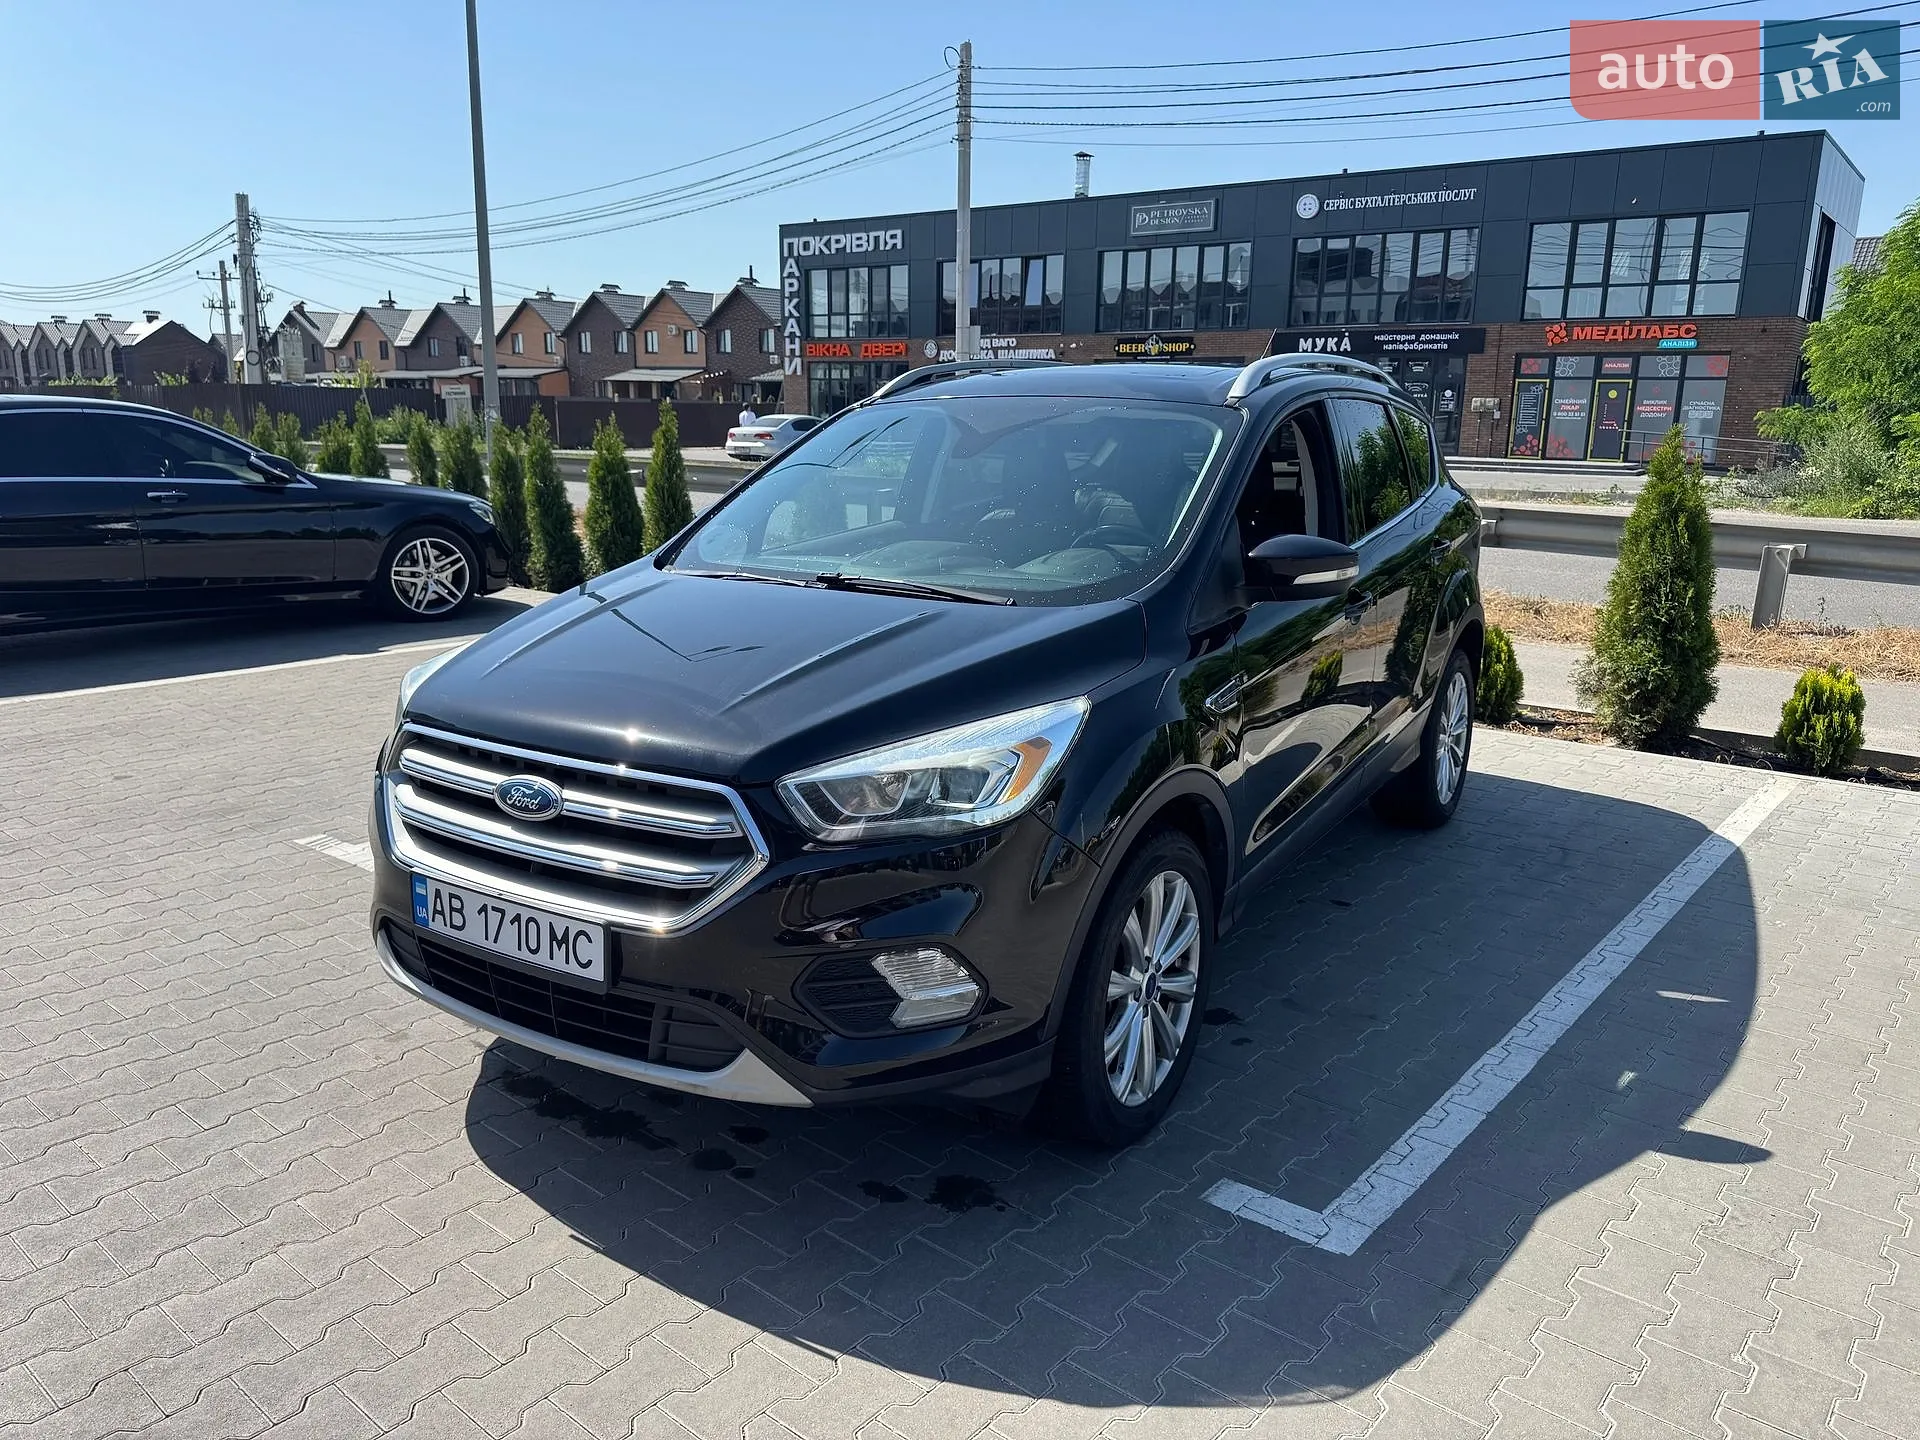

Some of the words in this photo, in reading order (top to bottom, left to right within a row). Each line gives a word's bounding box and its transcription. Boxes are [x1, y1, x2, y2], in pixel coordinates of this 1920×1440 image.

[1324, 198, 1354, 211] СЕРВІС
[1355, 191, 1437, 209] БУХГАЛТЕРСЬКИХ
[1438, 188, 1477, 203] ПОСЛУГ
[783, 229, 902, 257] ПОКРІВЛЯ
[805, 343, 853, 357] ВІКНА
[860, 342, 907, 359] ДВЕРІ
[992, 337, 1017, 347] ВАГО
[1119, 343, 1145, 353] BEER
[1162, 342, 1190, 352] SHOP
[997, 348, 1056, 360] ШАШЛИКА
[506, 785, 541, 810] Ford
[416, 905, 428, 919] UA
[431, 887, 467, 932] AB
[477, 903, 541, 956] 1710
[549, 921, 593, 970] MC
